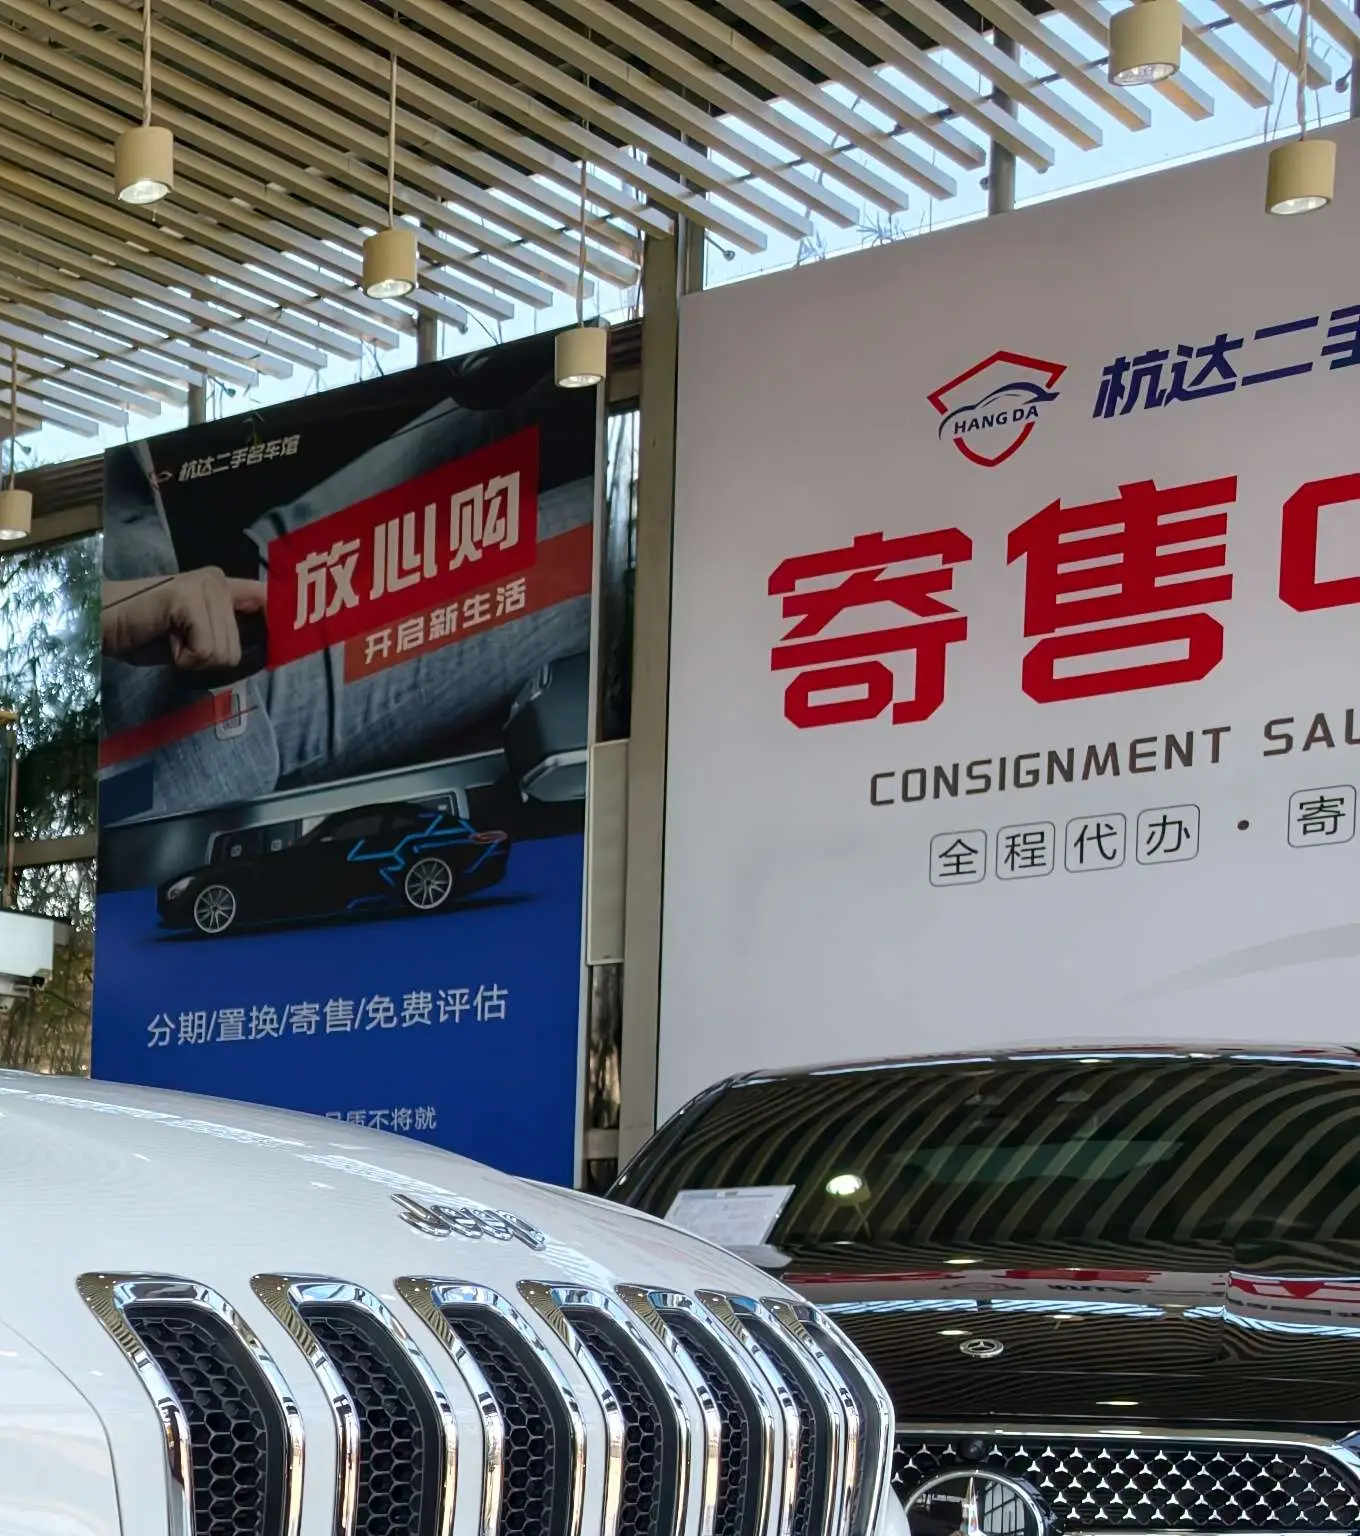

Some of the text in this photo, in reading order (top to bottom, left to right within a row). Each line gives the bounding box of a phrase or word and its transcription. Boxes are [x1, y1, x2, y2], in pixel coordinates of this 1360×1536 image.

[952, 403, 1040, 436] HANG DA
[178, 434, 301, 482] 杭达二手名车馆
[293, 470, 521, 630] 放心购
[364, 576, 528, 665] 开启新生活
[870, 725, 1232, 807] CONSIGNMENT
[146, 983, 510, 1049] 分期/置换/寄售/免费评估
